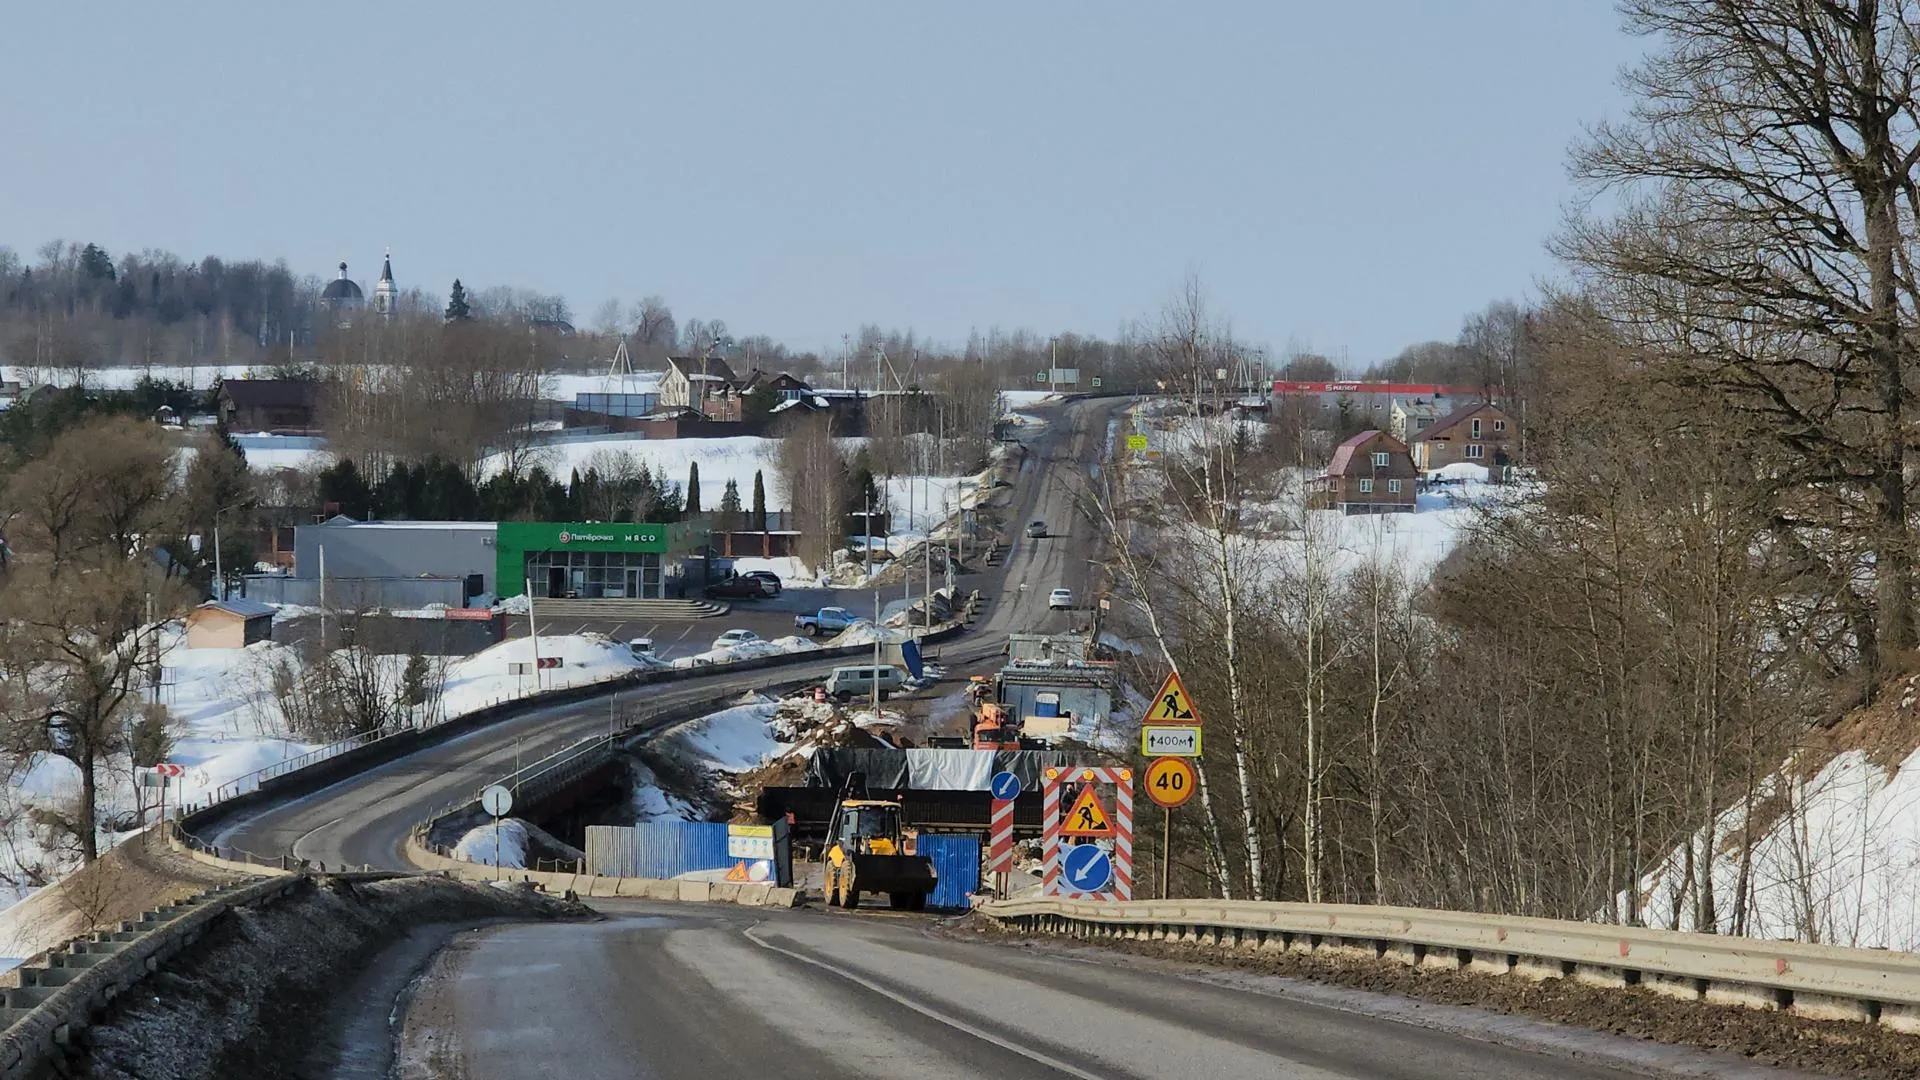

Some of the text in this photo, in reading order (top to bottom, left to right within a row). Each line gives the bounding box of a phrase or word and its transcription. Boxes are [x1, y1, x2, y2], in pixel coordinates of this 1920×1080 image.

[625, 534, 656, 542] МЯСО
[1157, 736, 1187, 746] 400м
[1156, 772, 1183, 790] 40
